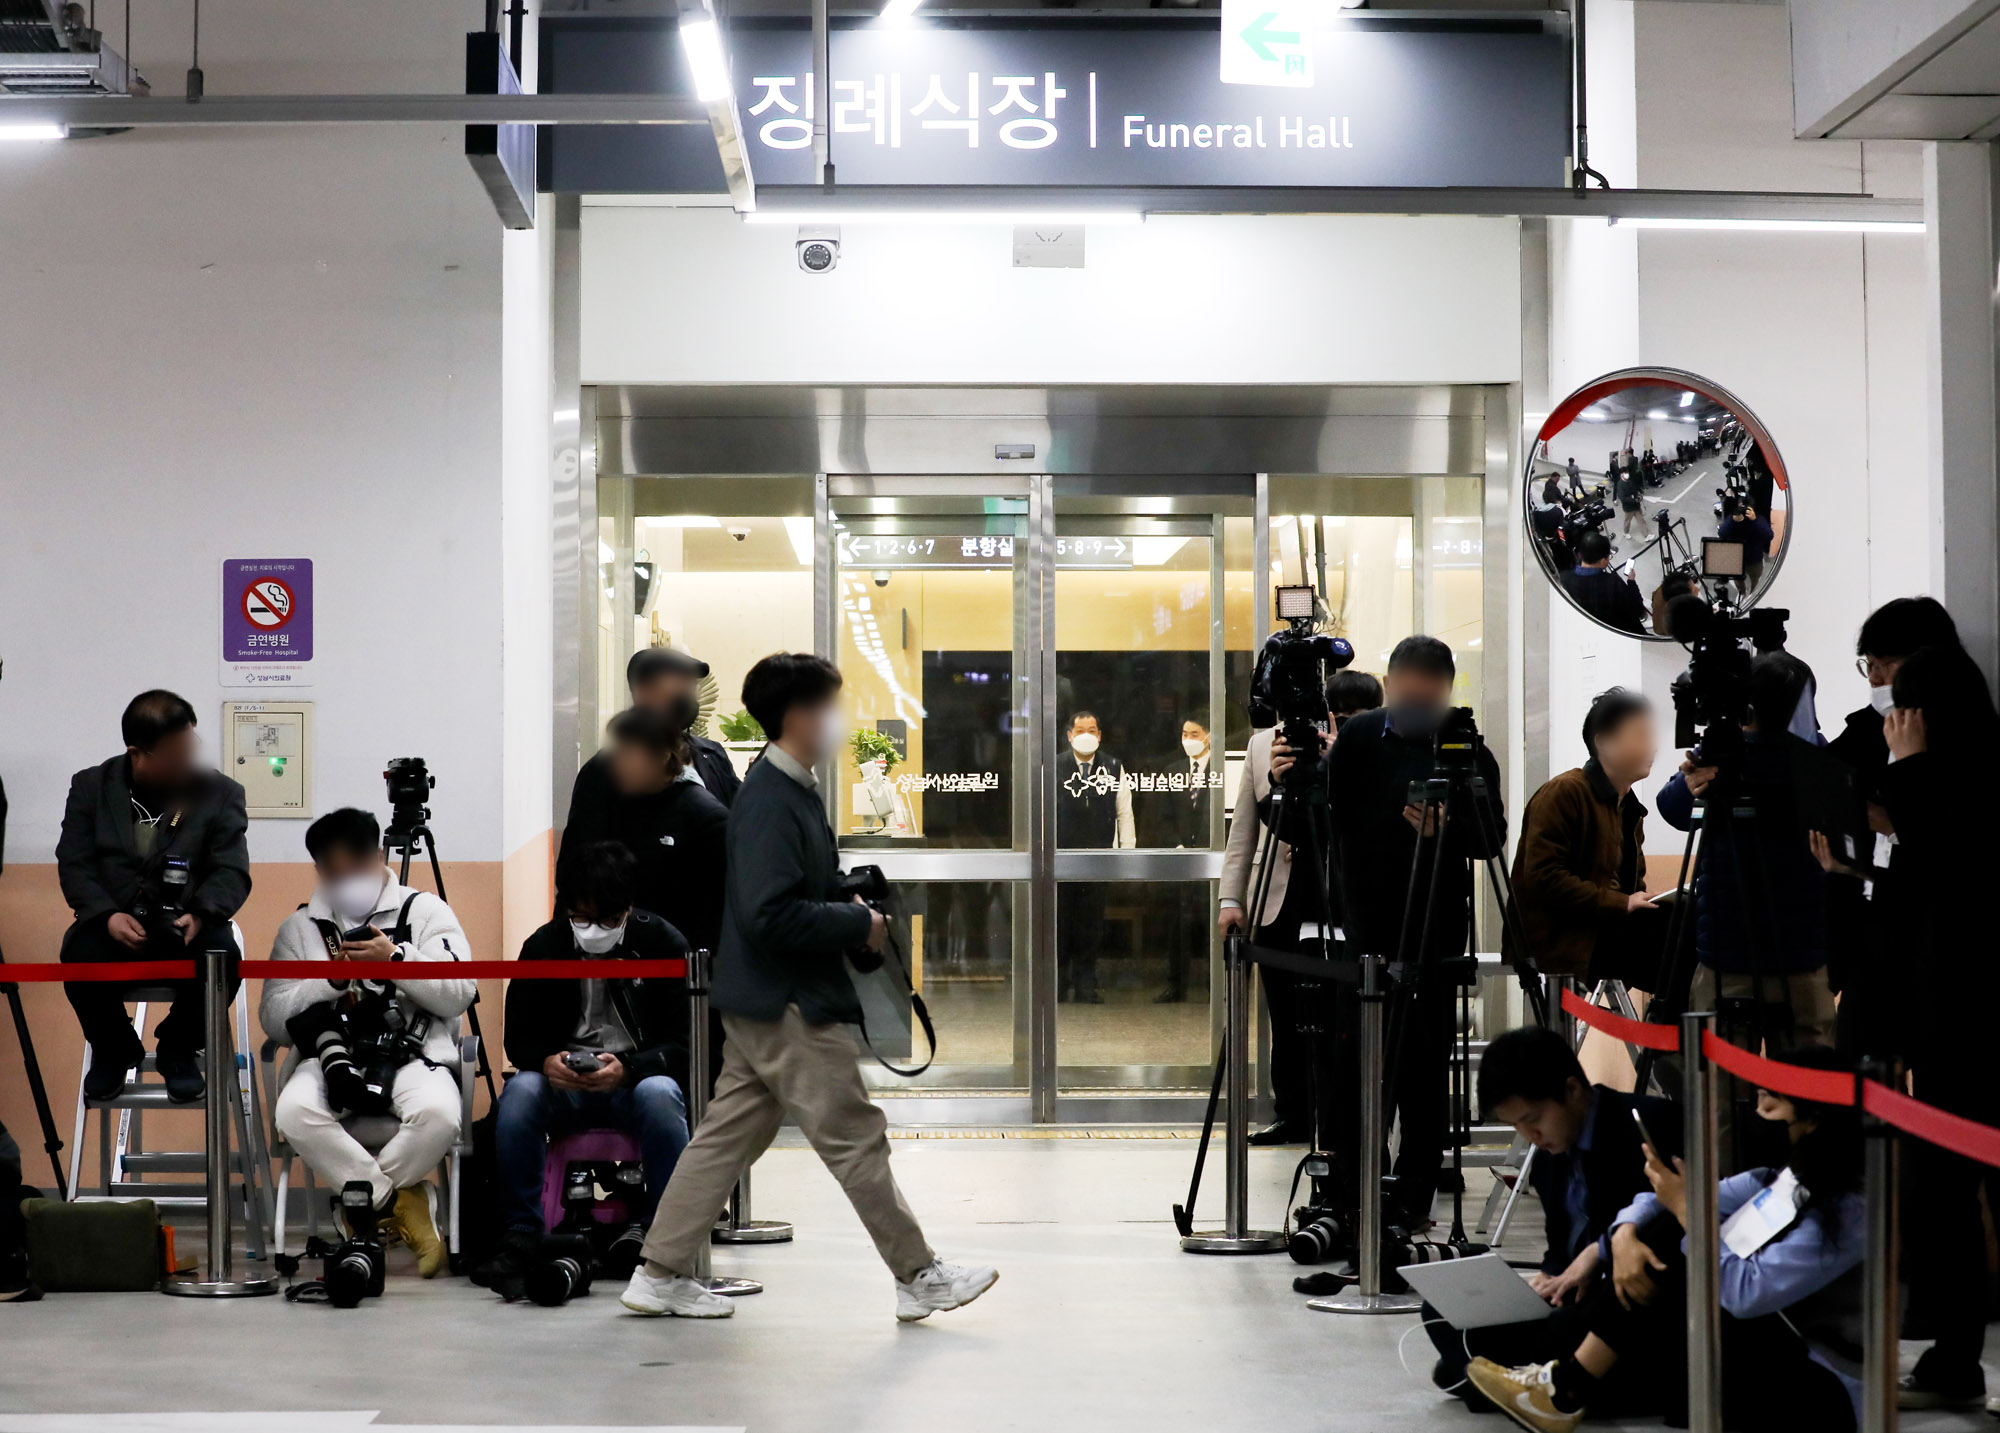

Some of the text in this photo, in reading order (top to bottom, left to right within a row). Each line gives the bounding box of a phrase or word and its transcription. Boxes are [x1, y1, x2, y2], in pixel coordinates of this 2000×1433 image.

[1122, 115, 1354, 149] Funeral Hall
[960, 537, 1013, 557] 분향실
[247, 634, 289, 647] 금연병원
[275, 649, 299, 657] Hospital
[257, 674, 291, 682] 성남시의료원
[325, 935, 339, 956] EOS
